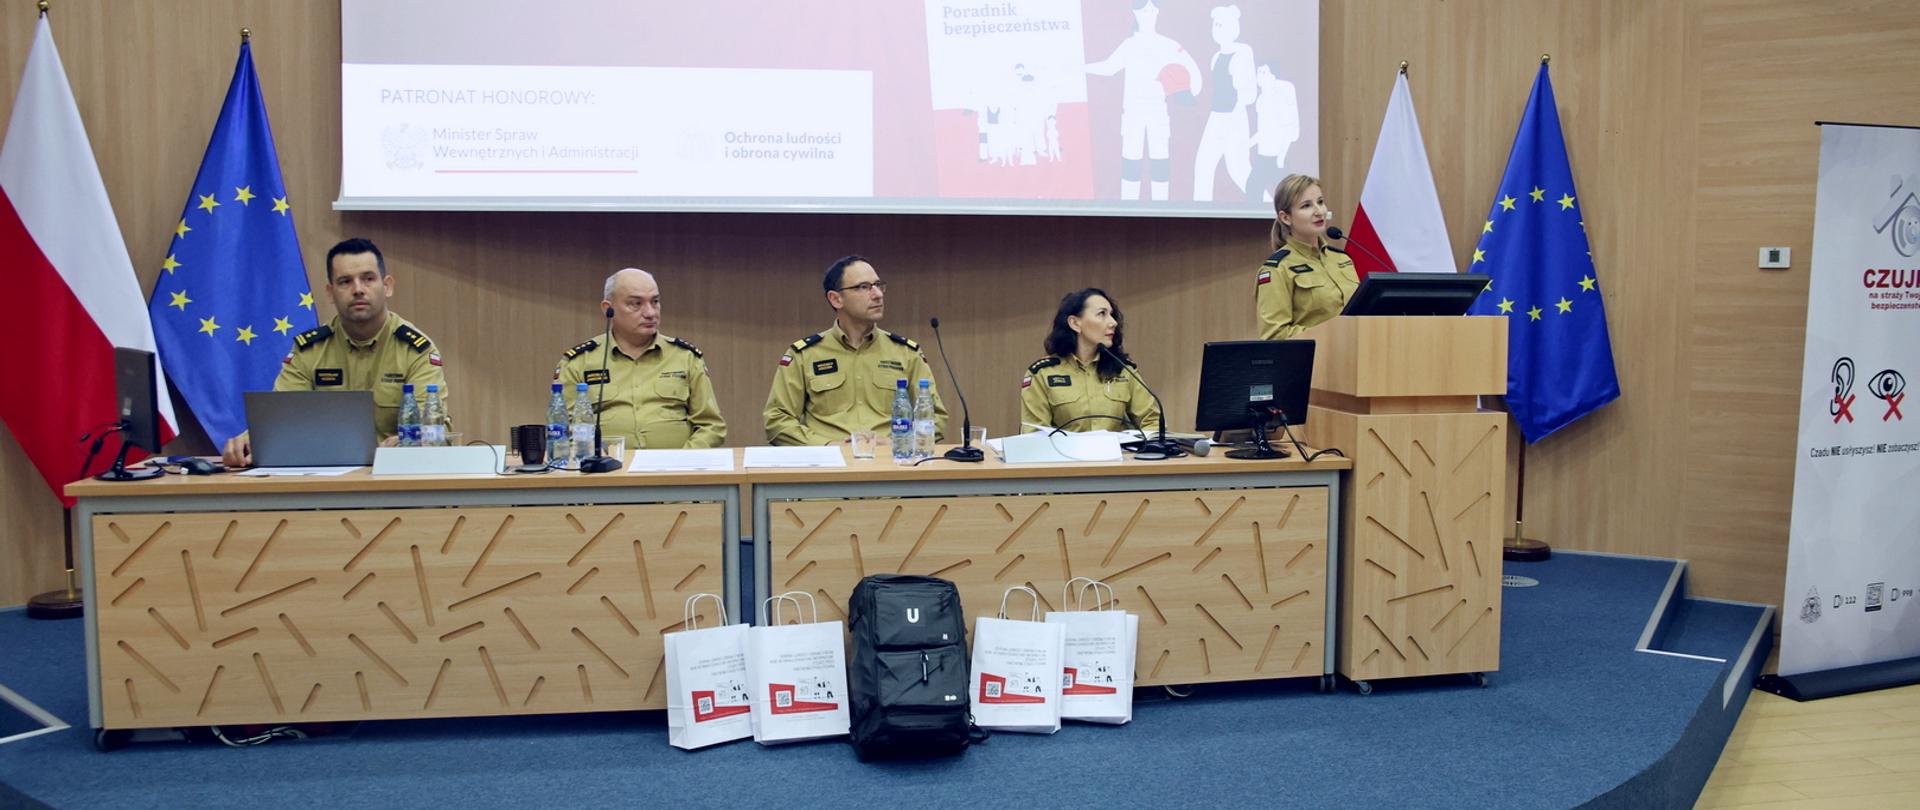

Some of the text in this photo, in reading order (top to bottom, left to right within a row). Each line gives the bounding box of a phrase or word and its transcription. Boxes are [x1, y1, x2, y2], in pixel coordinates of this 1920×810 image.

[943, 2, 1017, 18] Poradnik
[943, 18, 1070, 37] bezpieczeństwa
[381, 88, 596, 105] PATRONAT HONOROWY:
[433, 127, 538, 143] Minister Spraw
[724, 131, 841, 145] Ochrona ludności
[433, 146, 539, 160] Wewnętrznych
[549, 146, 639, 160] Administracji
[731, 146, 780, 159] obrona
[783, 147, 835, 162] cywilna
[1864, 269, 1920, 288] CZUJ
